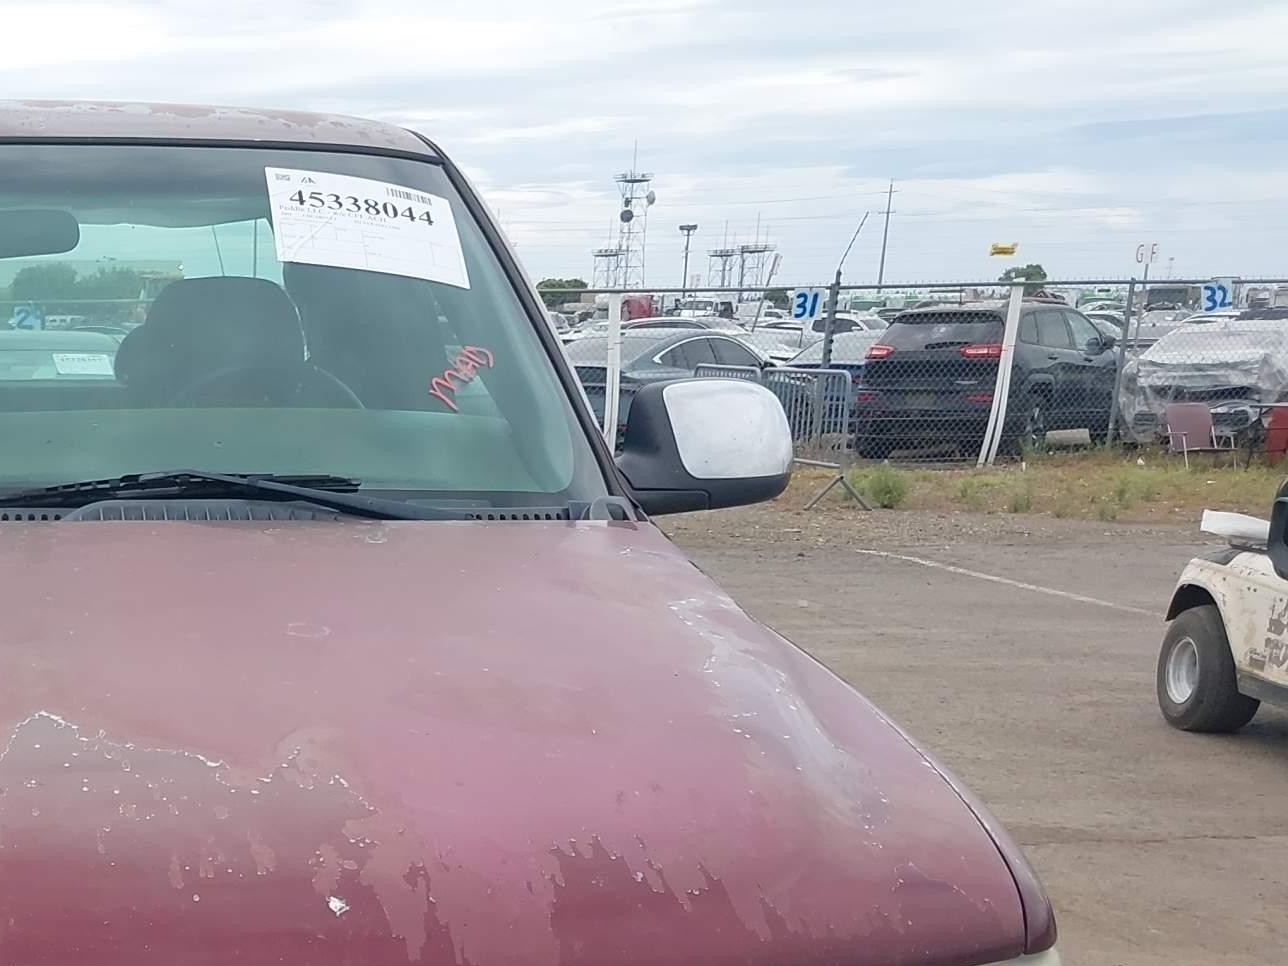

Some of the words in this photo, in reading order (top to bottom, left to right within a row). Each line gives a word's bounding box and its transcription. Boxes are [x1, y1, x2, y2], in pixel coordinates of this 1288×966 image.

[289, 189, 434, 226] 45338044
[794, 292, 819, 318] 31
[1203, 284, 1233, 312] 32
